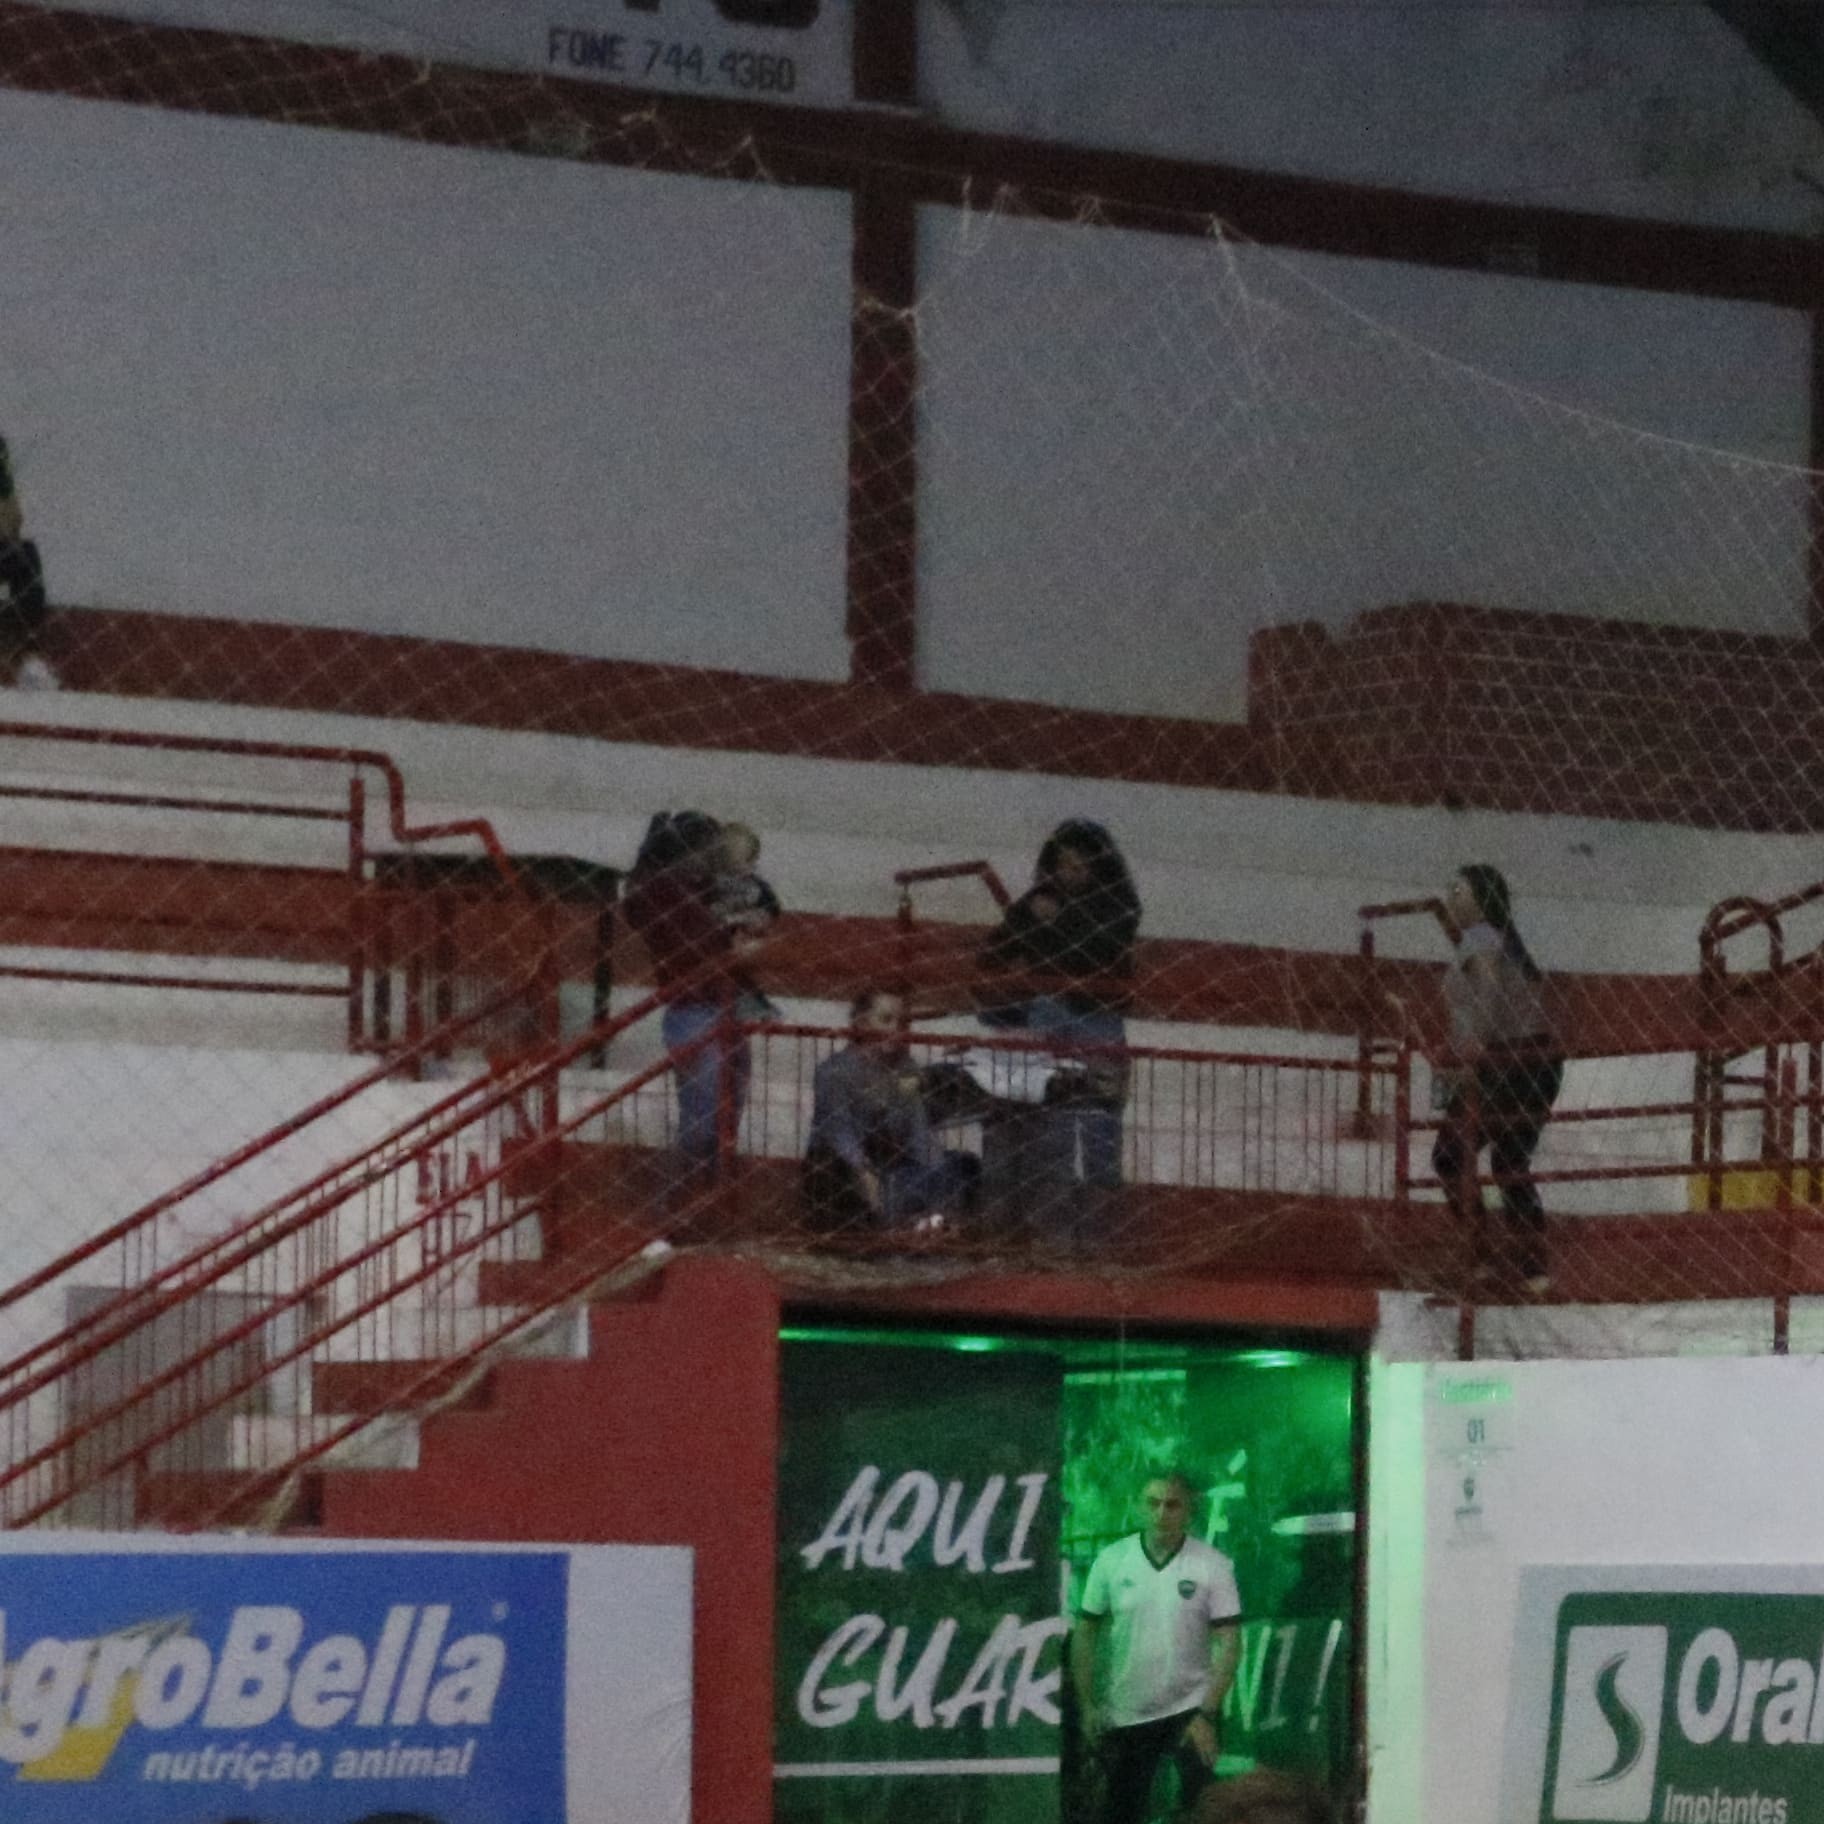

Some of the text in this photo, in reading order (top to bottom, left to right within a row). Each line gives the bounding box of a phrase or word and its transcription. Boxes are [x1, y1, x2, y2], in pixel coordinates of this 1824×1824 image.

[549, 27, 626, 71] FONE
[802, 1465, 1048, 1574] AQUI
[0, 1604, 506, 1764] groBella
[142, 1739, 476, 1789] nutrição animal
